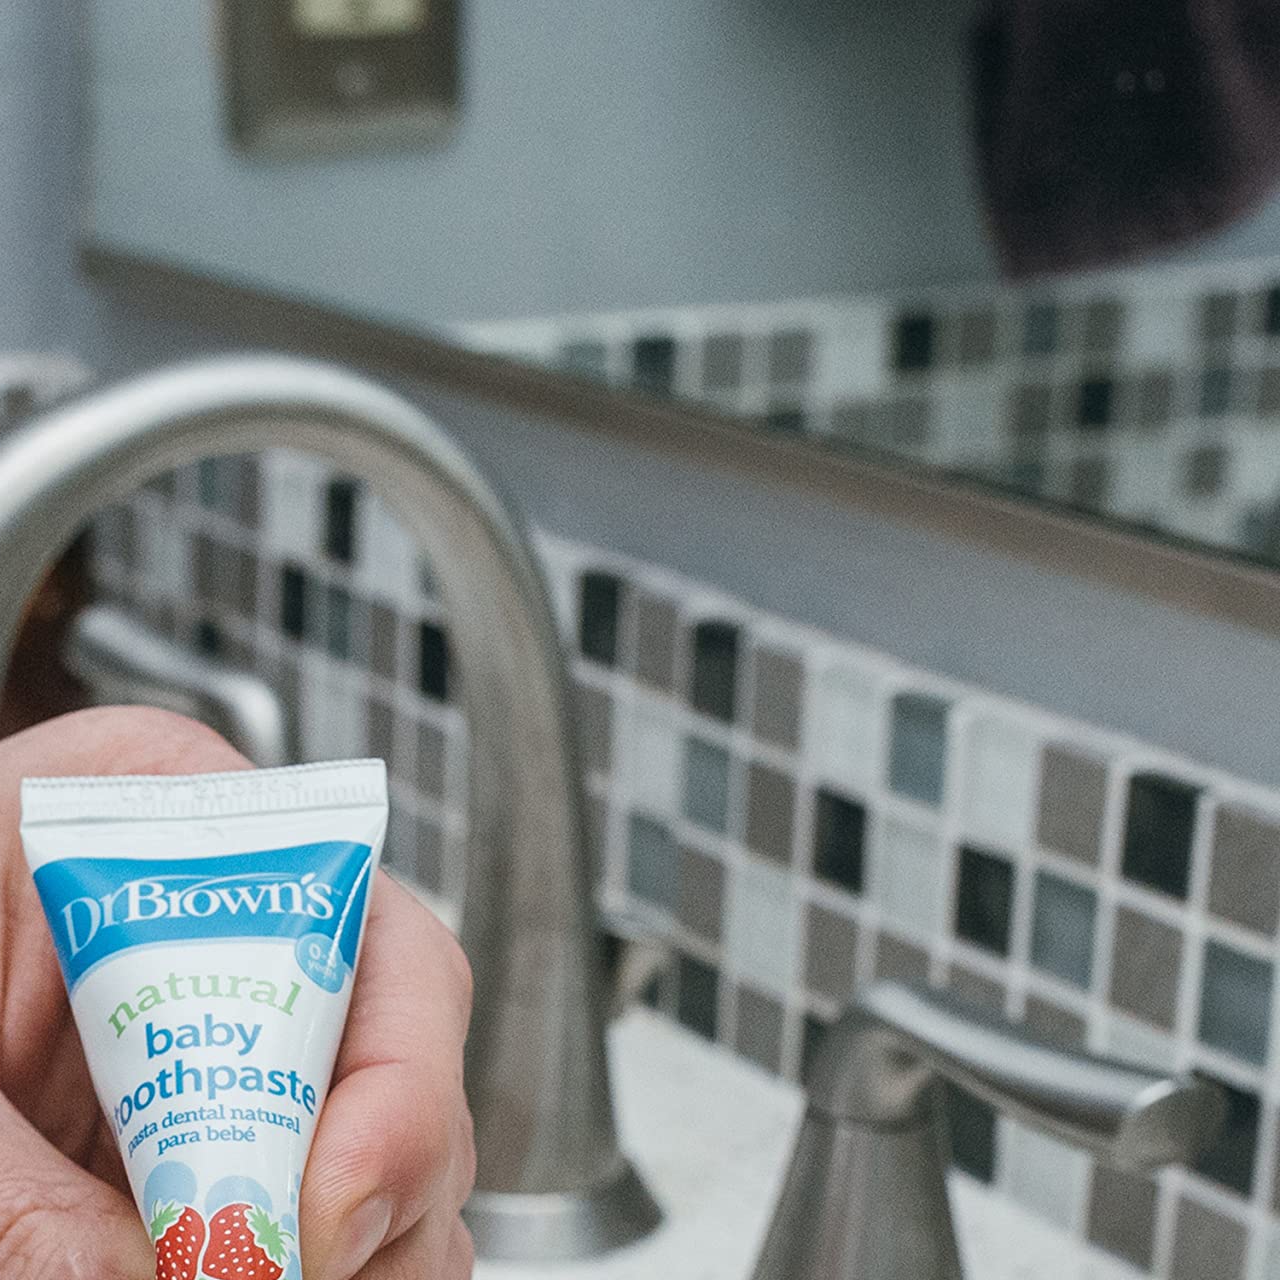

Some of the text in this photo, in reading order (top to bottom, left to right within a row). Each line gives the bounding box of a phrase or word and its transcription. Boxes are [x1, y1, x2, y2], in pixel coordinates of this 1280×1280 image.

[108, 971, 302, 1038] natural
[145, 1013, 263, 1059] baby
[114, 1059, 317, 1136] toothpaste
[127, 1104, 301, 1158] pasta dental natural
[157, 1124, 256, 1156] para bebé
